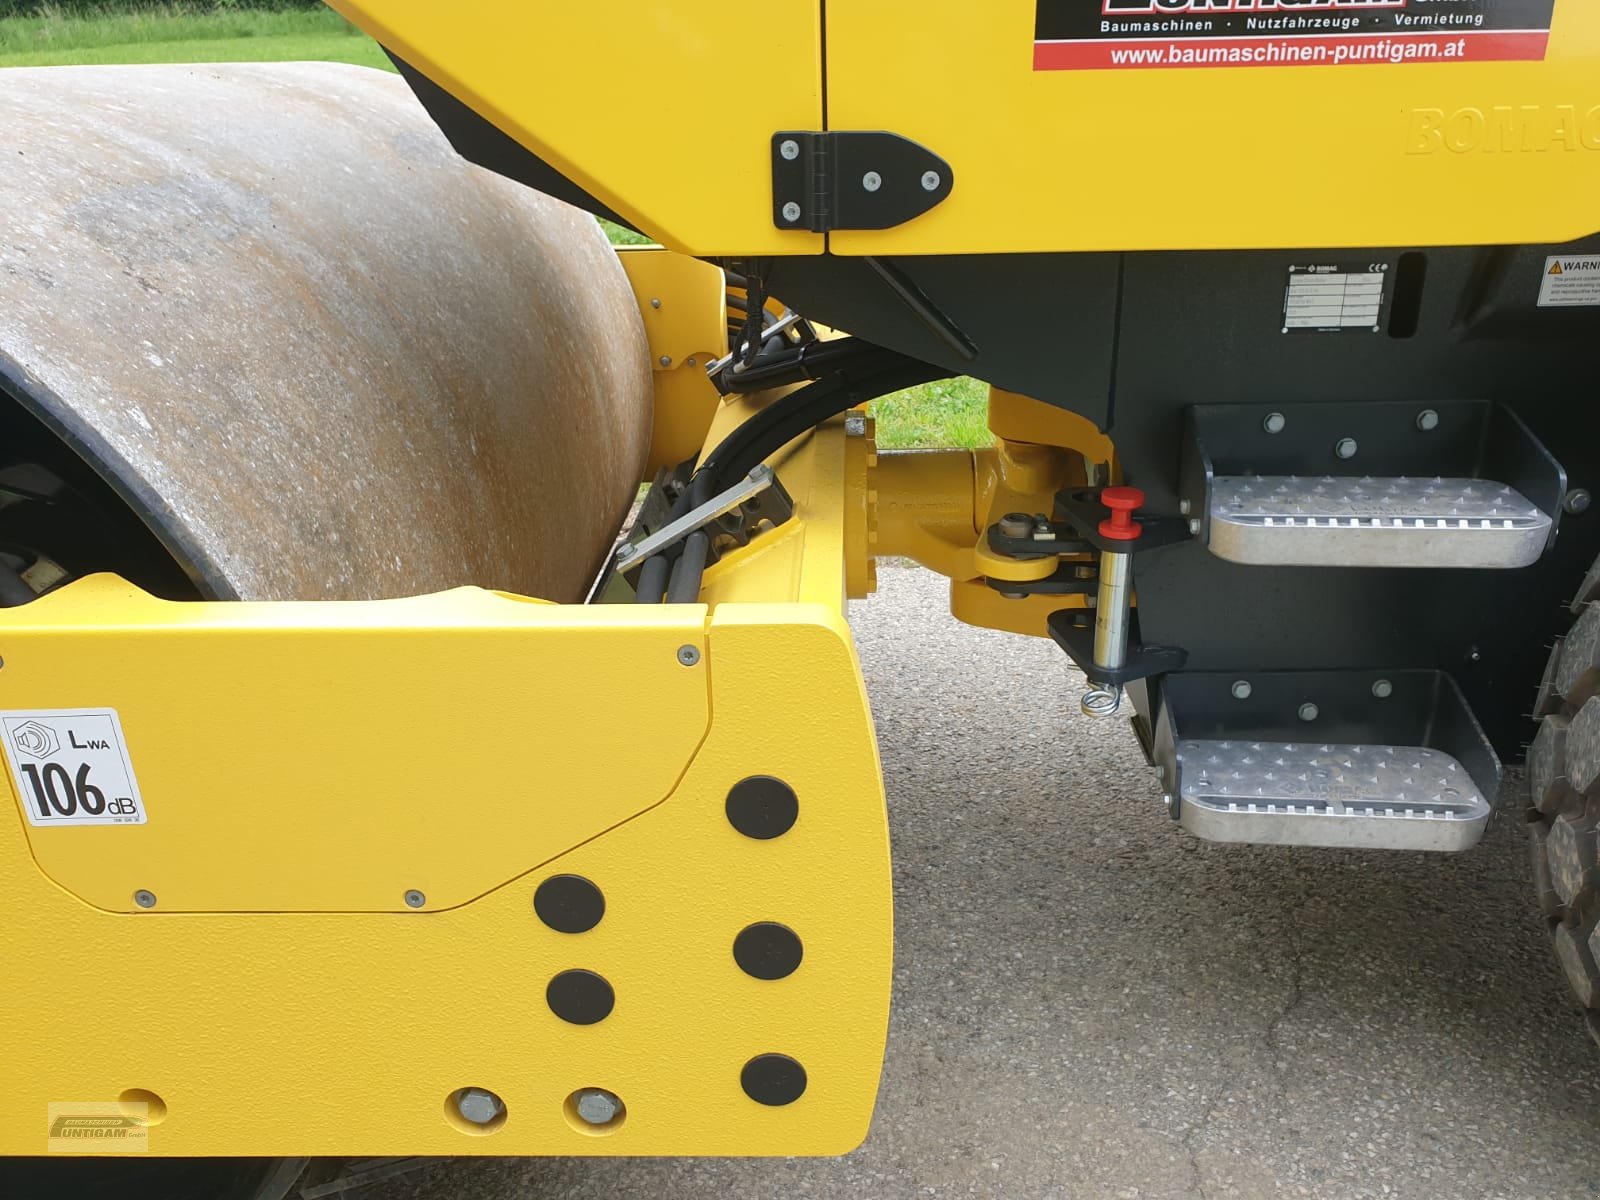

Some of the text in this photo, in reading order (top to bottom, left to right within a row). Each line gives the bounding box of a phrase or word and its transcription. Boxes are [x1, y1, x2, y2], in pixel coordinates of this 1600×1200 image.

[1100, 13, 1484, 32] Baumaschinen Nutzfahrzeuge Vermietung
[1111, 38, 1466, 64] www.baumaschinen-puntigam.at
[21, 762, 136, 816] 106 dB
